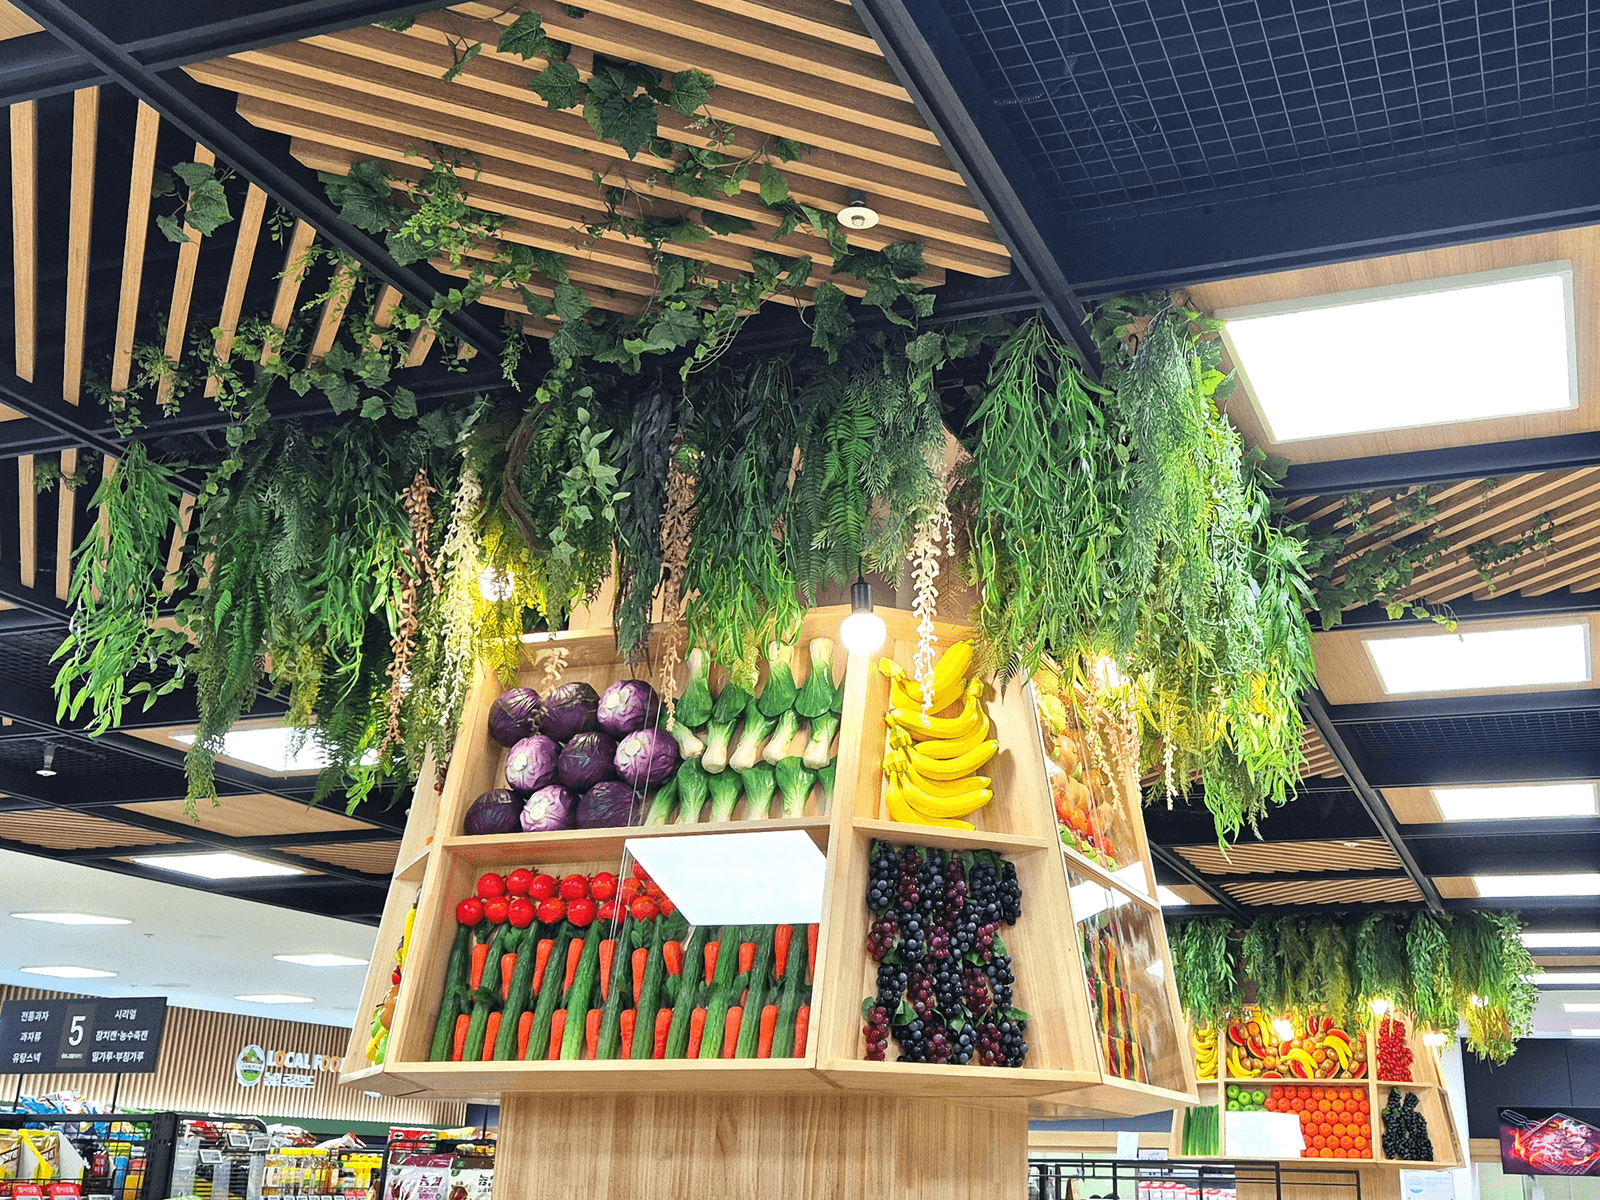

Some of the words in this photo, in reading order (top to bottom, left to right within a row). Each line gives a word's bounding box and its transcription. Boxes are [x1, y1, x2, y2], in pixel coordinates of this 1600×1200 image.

[21, 1011, 50, 1022] 전통과자
[114, 1009, 137, 1020] 시리얼
[68, 1016, 86, 1046] 5
[20, 1032, 42, 1042] 과자류
[266, 1050, 310, 1068] LOCAL
